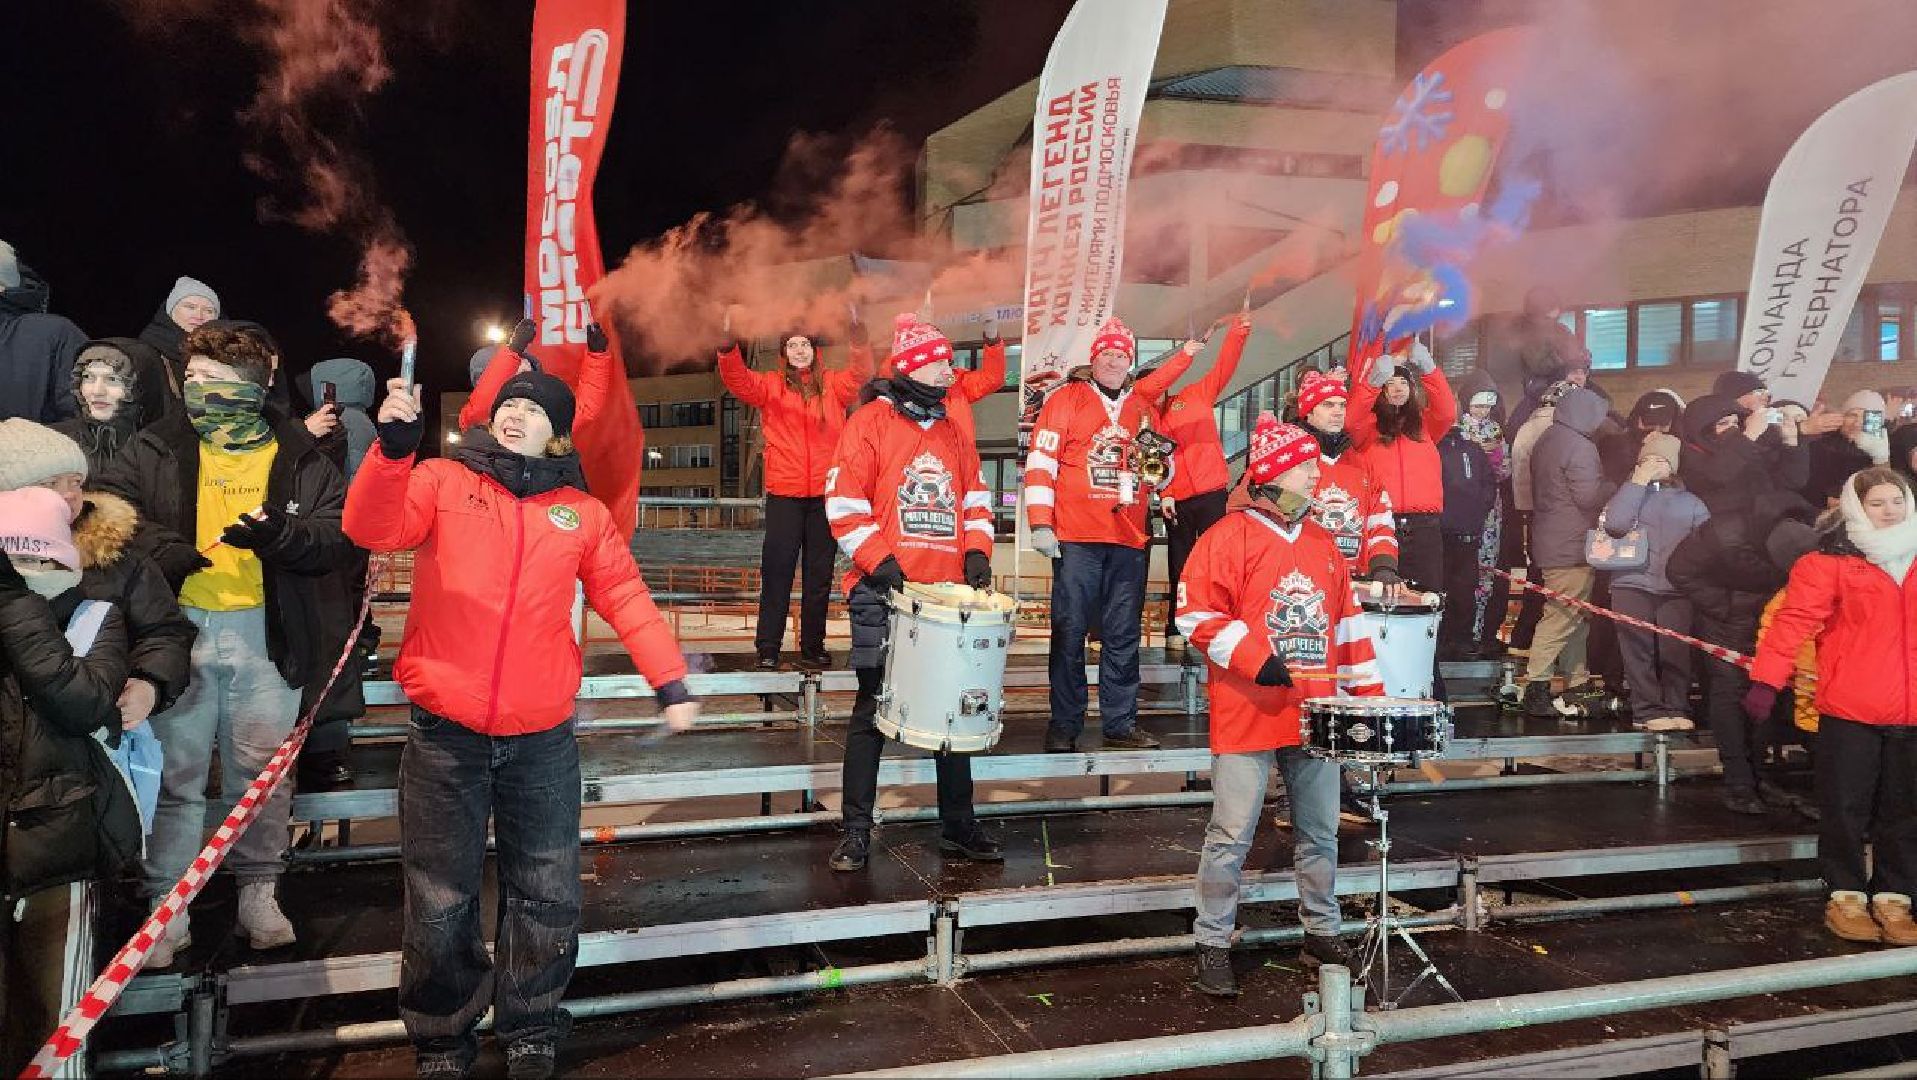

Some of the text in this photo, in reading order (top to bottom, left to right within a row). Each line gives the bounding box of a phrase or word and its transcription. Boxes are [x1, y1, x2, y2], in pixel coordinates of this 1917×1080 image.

[1068, 80, 1099, 204] РОССИИ
[1093, 77, 1122, 214] ПОДМОСКОВЬЯ
[1027, 89, 1076, 336] МАТЧ ЛЕГЕНД
[1081, 218, 1107, 316] ЖИТЕЛЯМИ
[1781, 176, 1873, 378] ГУБЕРНАТОРА
